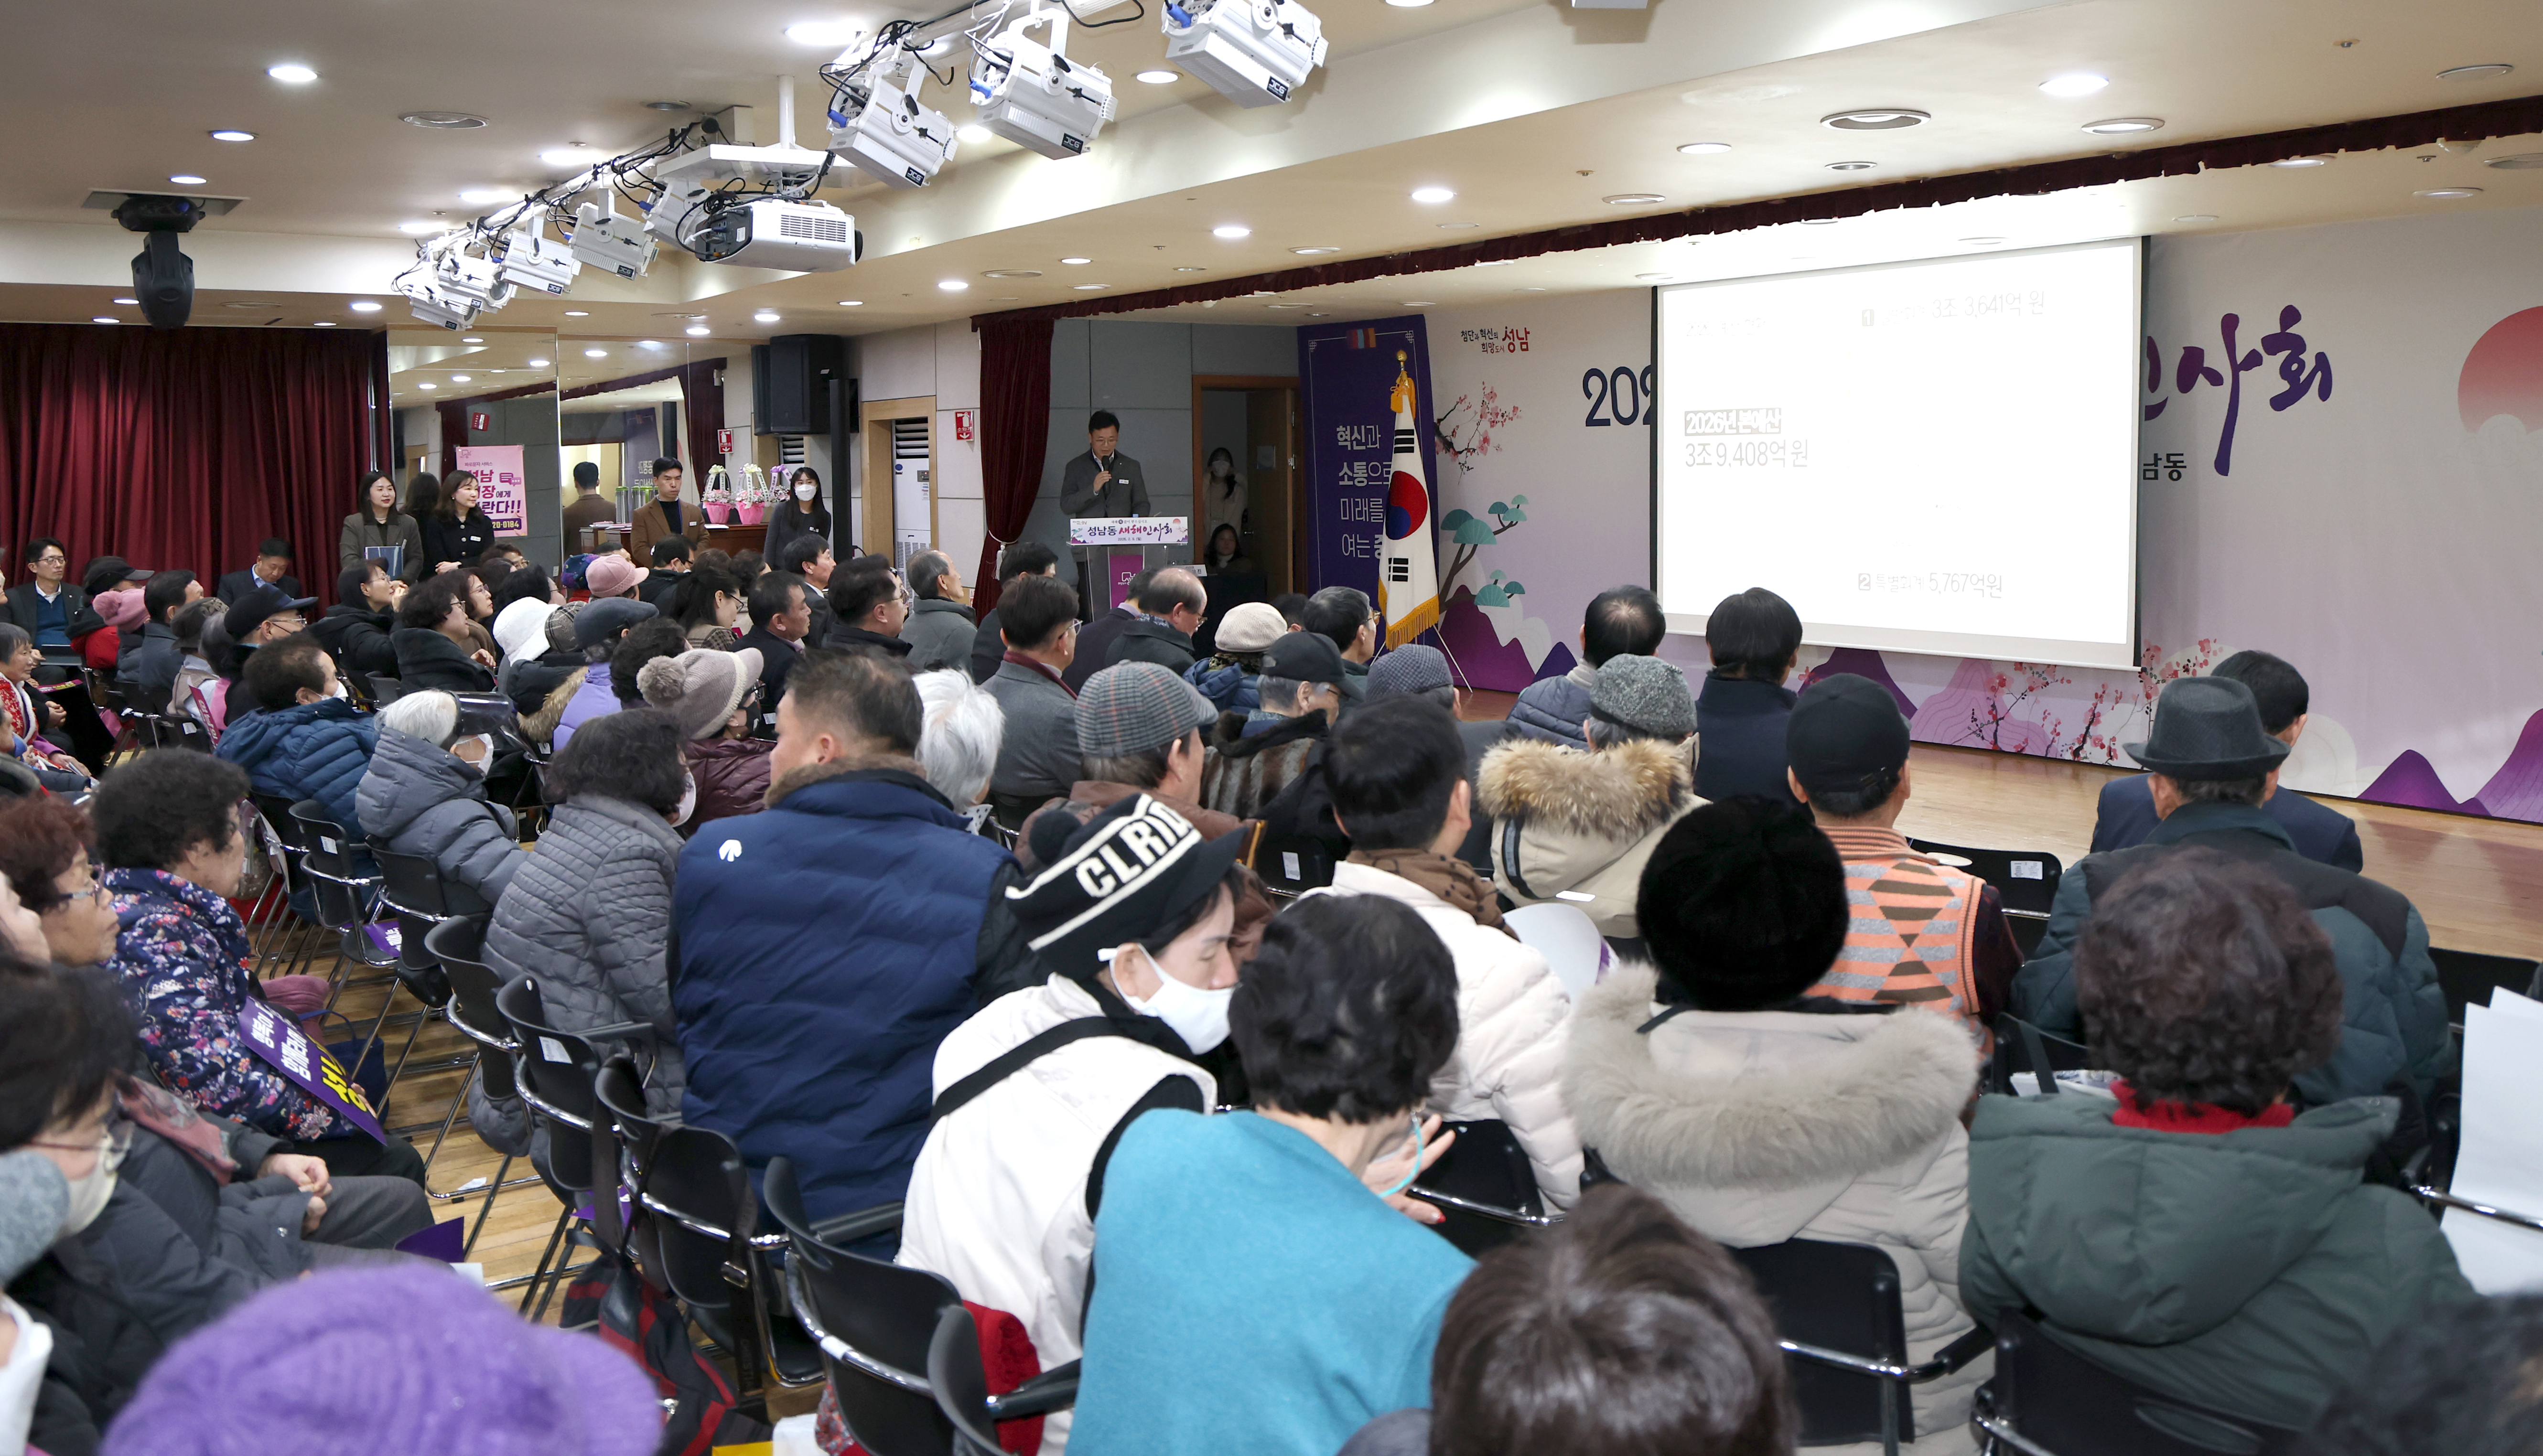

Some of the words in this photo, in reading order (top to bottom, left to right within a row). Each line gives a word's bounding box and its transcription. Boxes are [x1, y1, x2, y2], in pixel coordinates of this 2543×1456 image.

[1269, 79, 1285, 94] JCG
[1064, 136, 1080, 148] JCG
[907, 169, 922, 181] JCG
[1932, 298, 1958, 319] 3조
[1964, 292, 2021, 319] 3,641억
[2028, 290, 2044, 315] 원
[1461, 330, 1480, 342] 첨단과
[1480, 328, 1498, 341] 혁신의
[1502, 326, 1530, 353] 성남
[1481, 342, 1505, 354] 희망도시
[1686, 409, 1737, 434] 2026년
[1737, 407, 1782, 434] 본예산
[1336, 424, 1381, 451] 혁신과
[1685, 442, 1713, 468] 3조
[1716, 439, 1786, 470] 9,408억
[1790, 439, 1808, 468] 원
[1340, 497, 1384, 523] 미래를
[1088, 526, 1117, 536] 성남동
[1342, 534, 1371, 558] 여는
